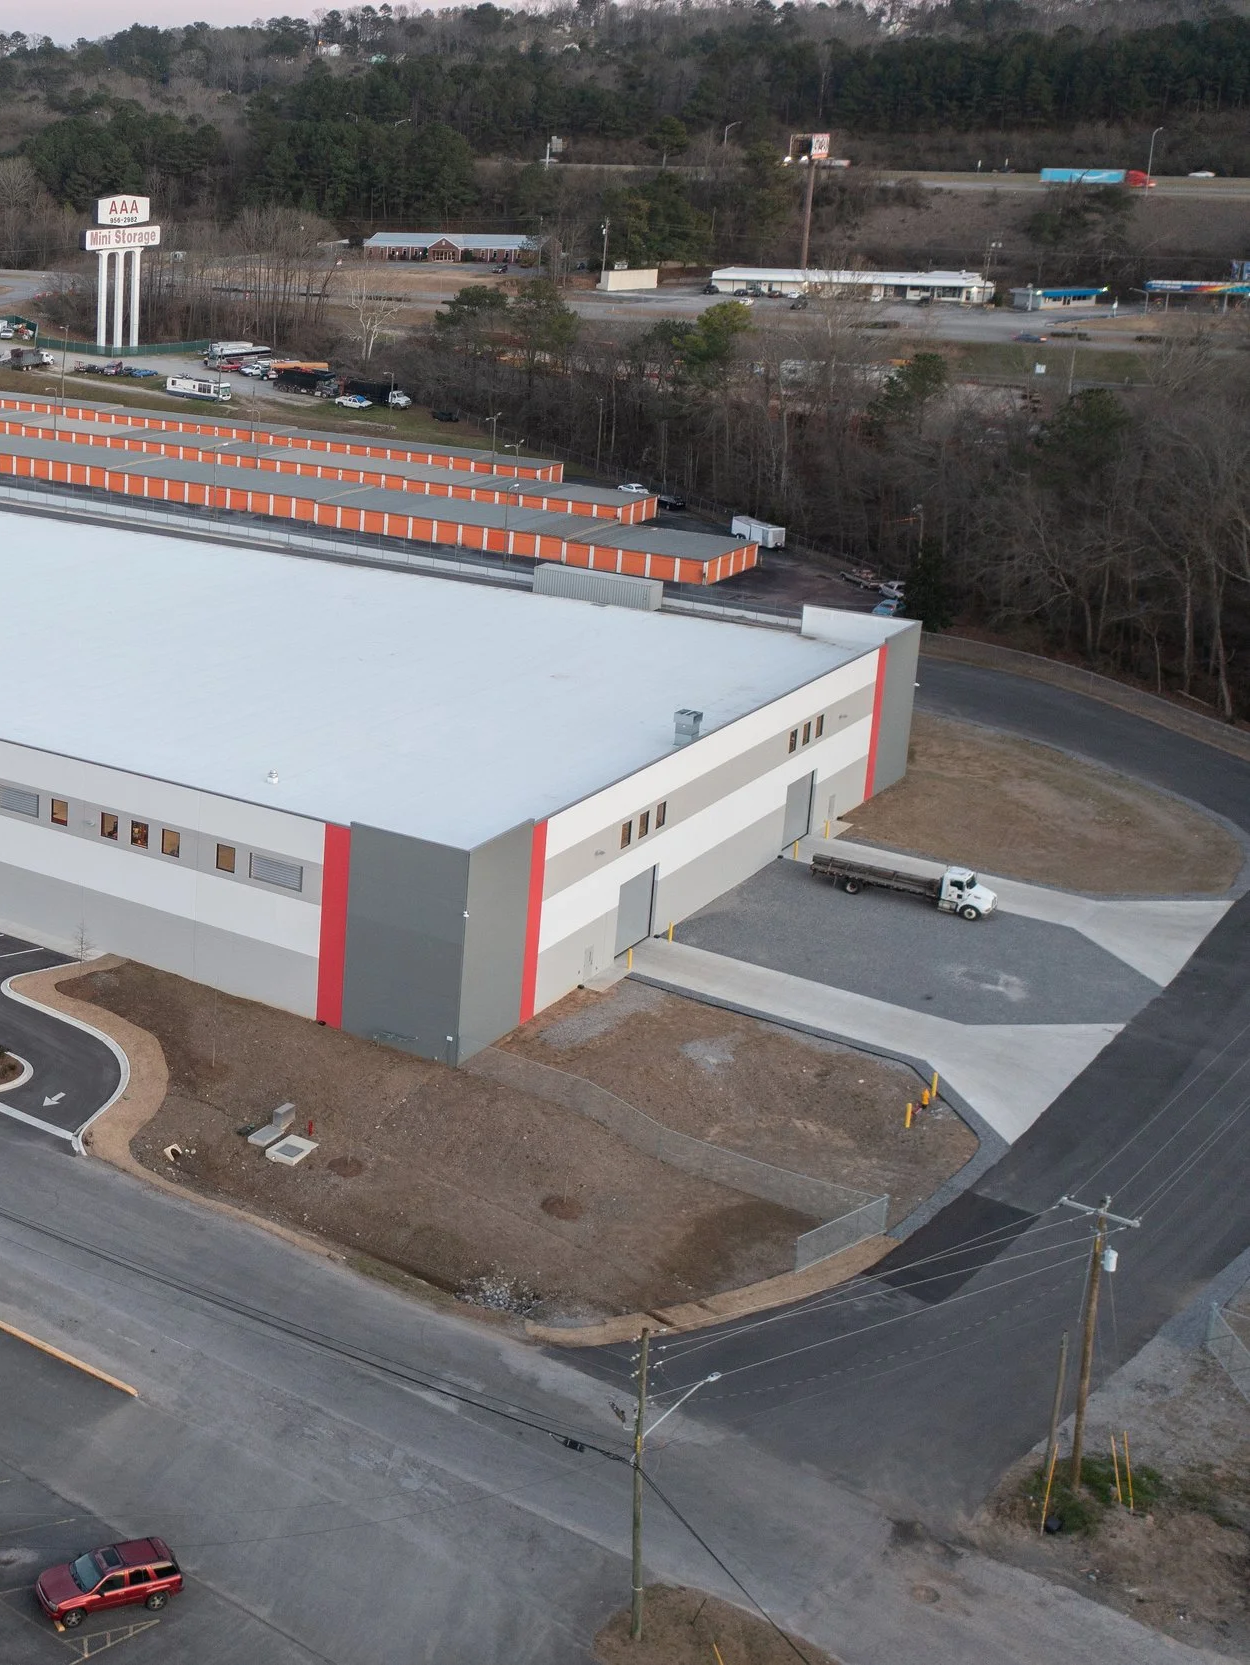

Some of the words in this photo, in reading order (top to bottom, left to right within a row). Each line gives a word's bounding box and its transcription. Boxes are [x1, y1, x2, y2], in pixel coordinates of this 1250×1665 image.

[109, 200, 139, 214] AAA
[90, 231, 111, 246] Mini
[114, 229, 156, 245] Storage
